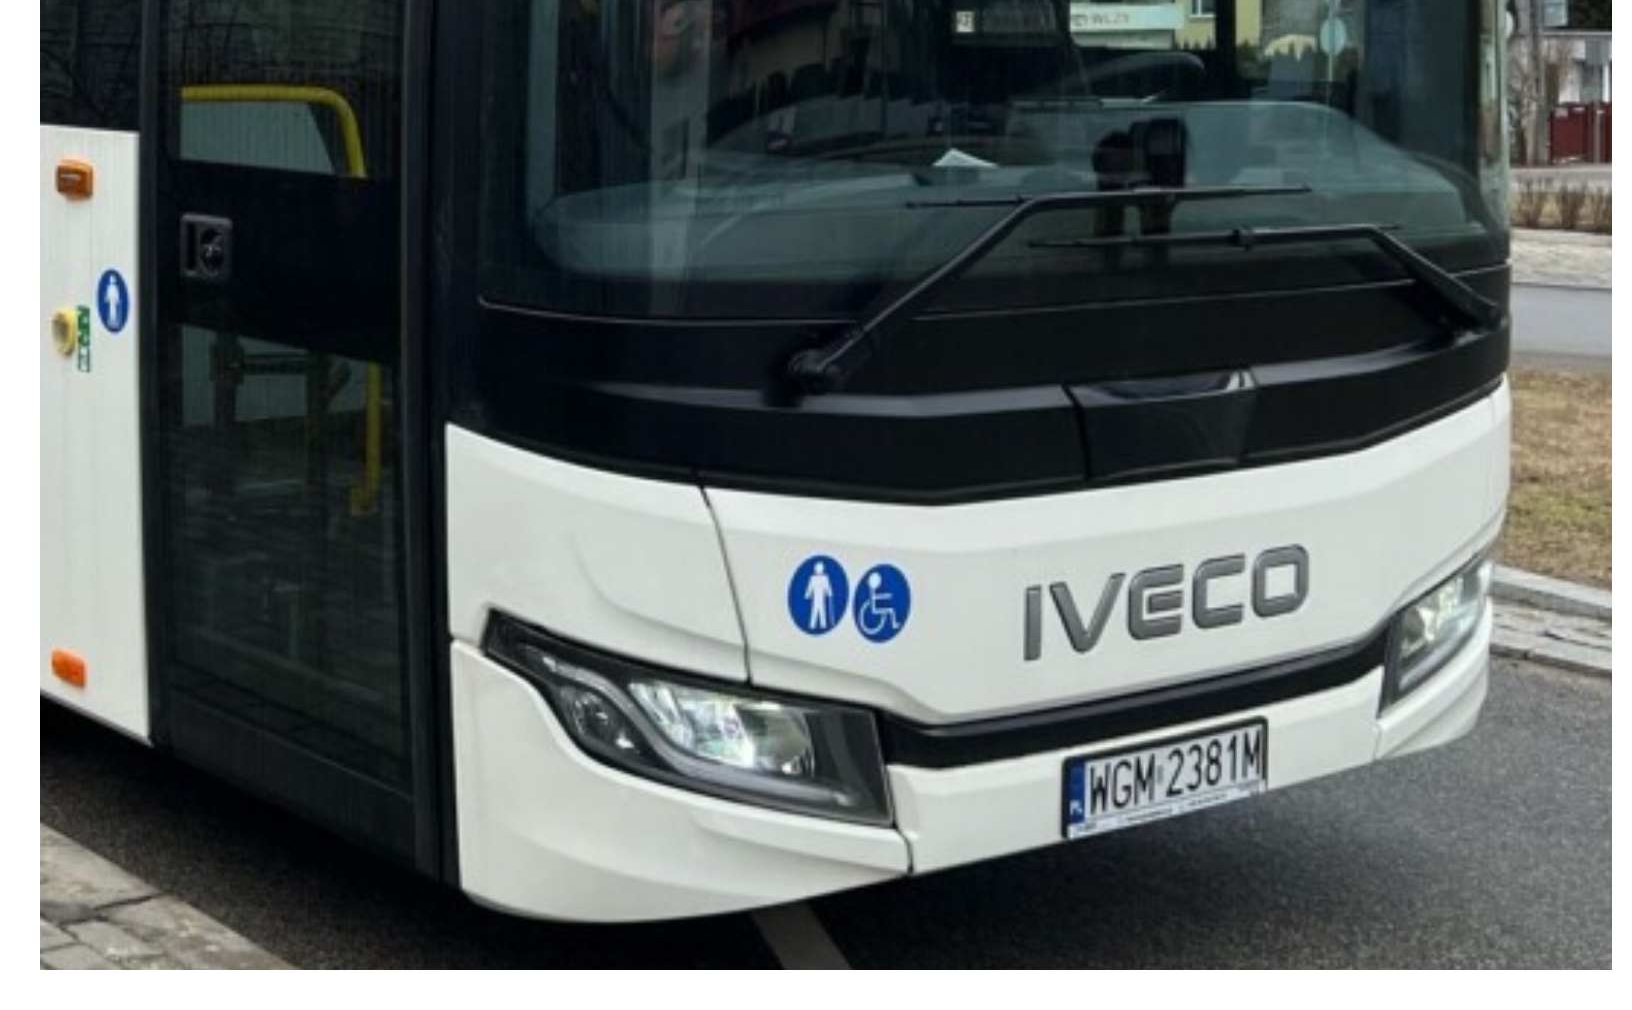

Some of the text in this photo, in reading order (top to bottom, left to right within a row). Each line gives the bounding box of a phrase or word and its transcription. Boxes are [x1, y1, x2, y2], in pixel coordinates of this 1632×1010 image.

[1023, 543, 1310, 662] IVECO
[1090, 752, 1156, 815] WGM
[1166, 730, 1261, 798] 2381M
